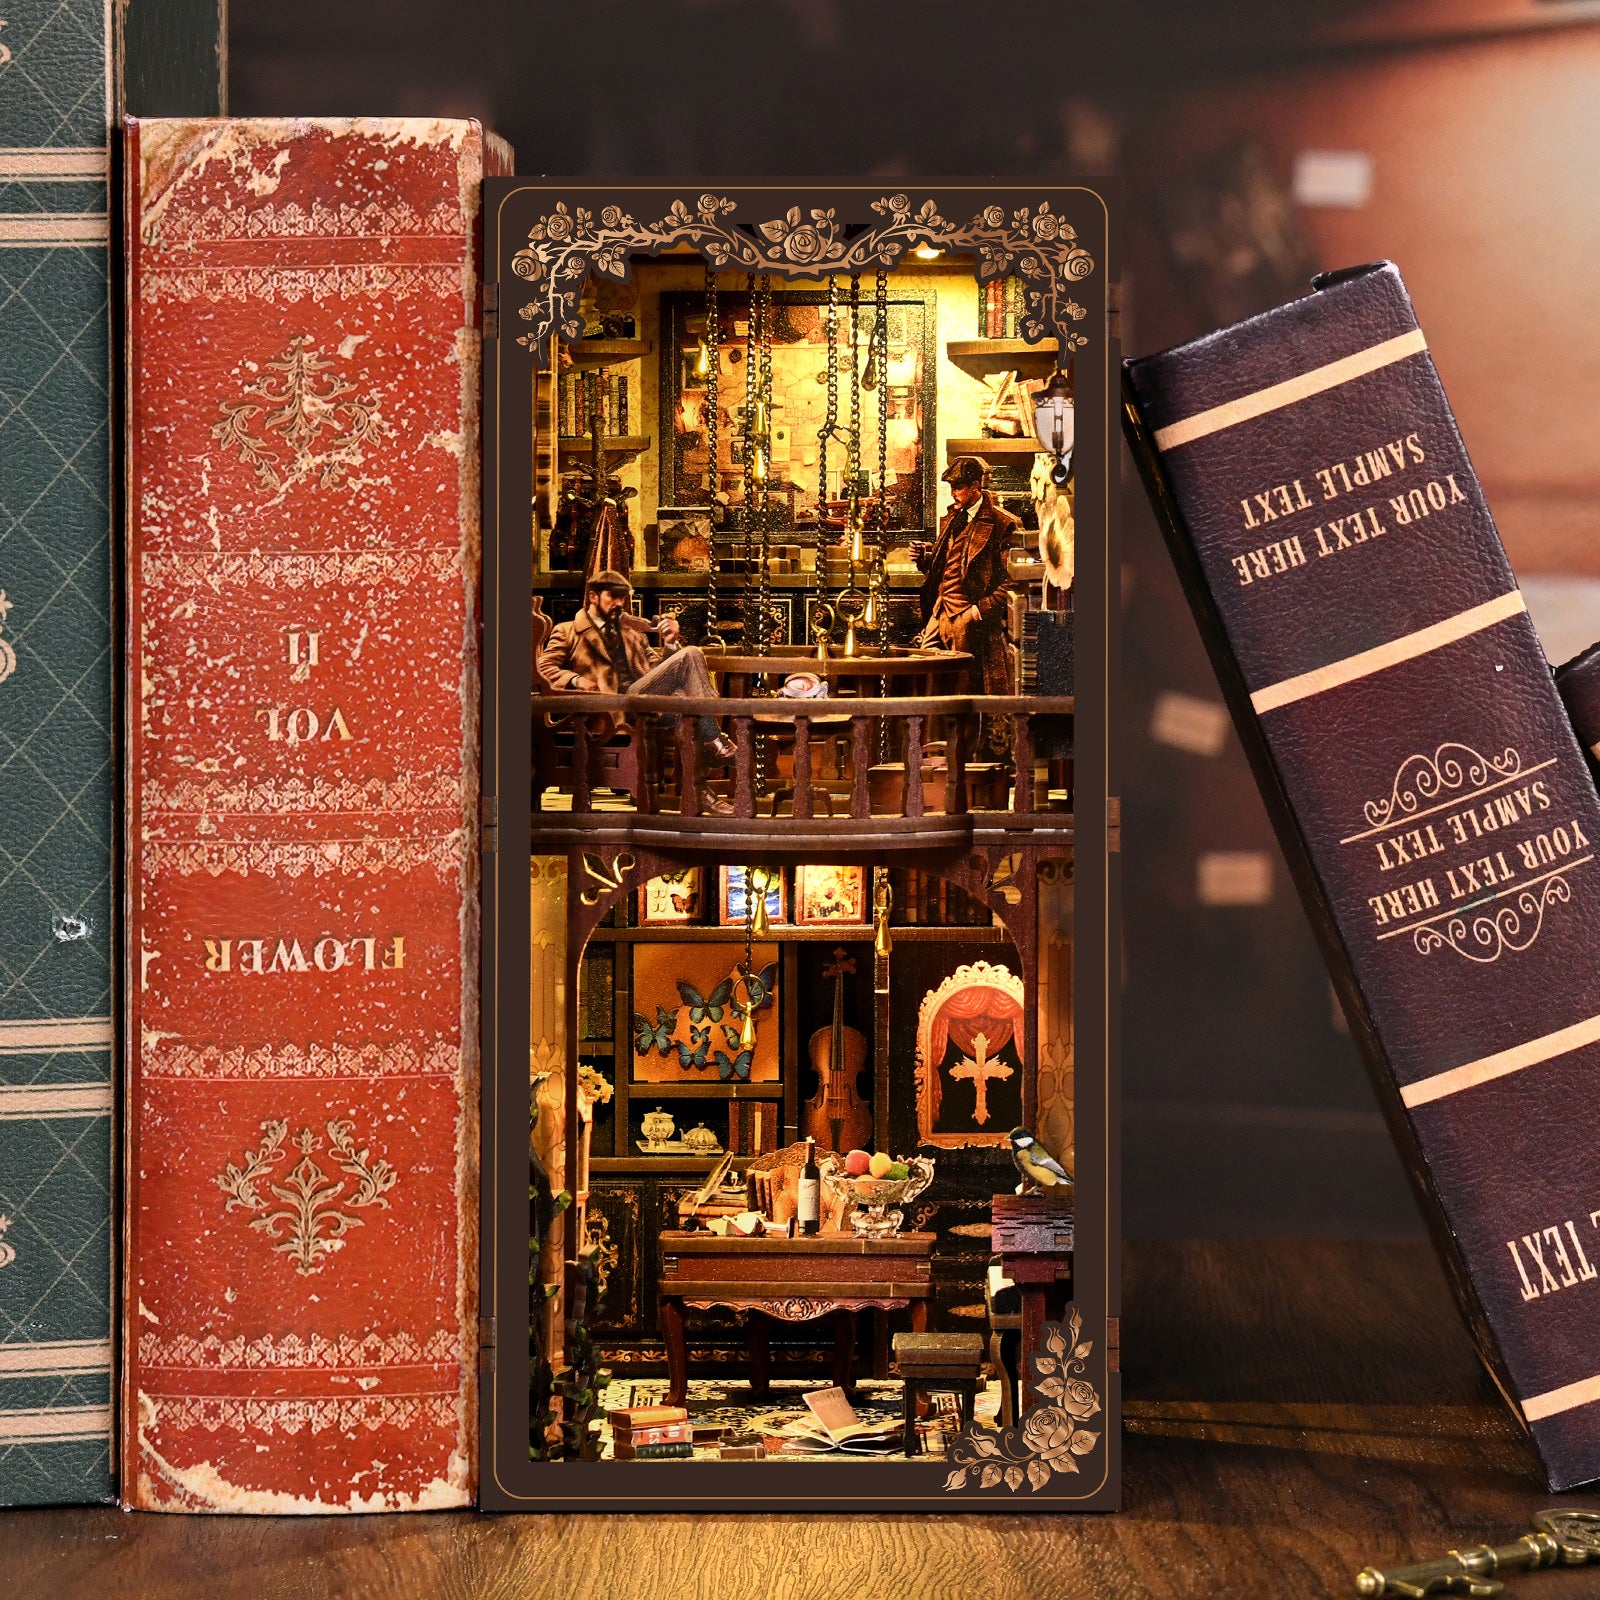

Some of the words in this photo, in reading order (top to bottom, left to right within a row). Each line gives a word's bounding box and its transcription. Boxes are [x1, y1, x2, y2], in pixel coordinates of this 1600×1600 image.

[1315, 431, 1424, 500] SAMPLE
[1241, 479, 1312, 530] TEXT
[1388, 473, 1468, 525] YOUR
[1314, 506, 1387, 558] TEXT
[1232, 535, 1307, 586] HERE
[256, 708, 353, 742] VOL
[1447, 780, 1551, 845] SAMPLE
[1376, 824, 1444, 876] TEXT
[1516, 819, 1590, 870] YOUR
[1445, 851, 1515, 900] TEXT
[1368, 878, 1440, 926] HERE
[203, 937, 405, 973] FLOWER
[1507, 1220, 1599, 1302] TEXT
